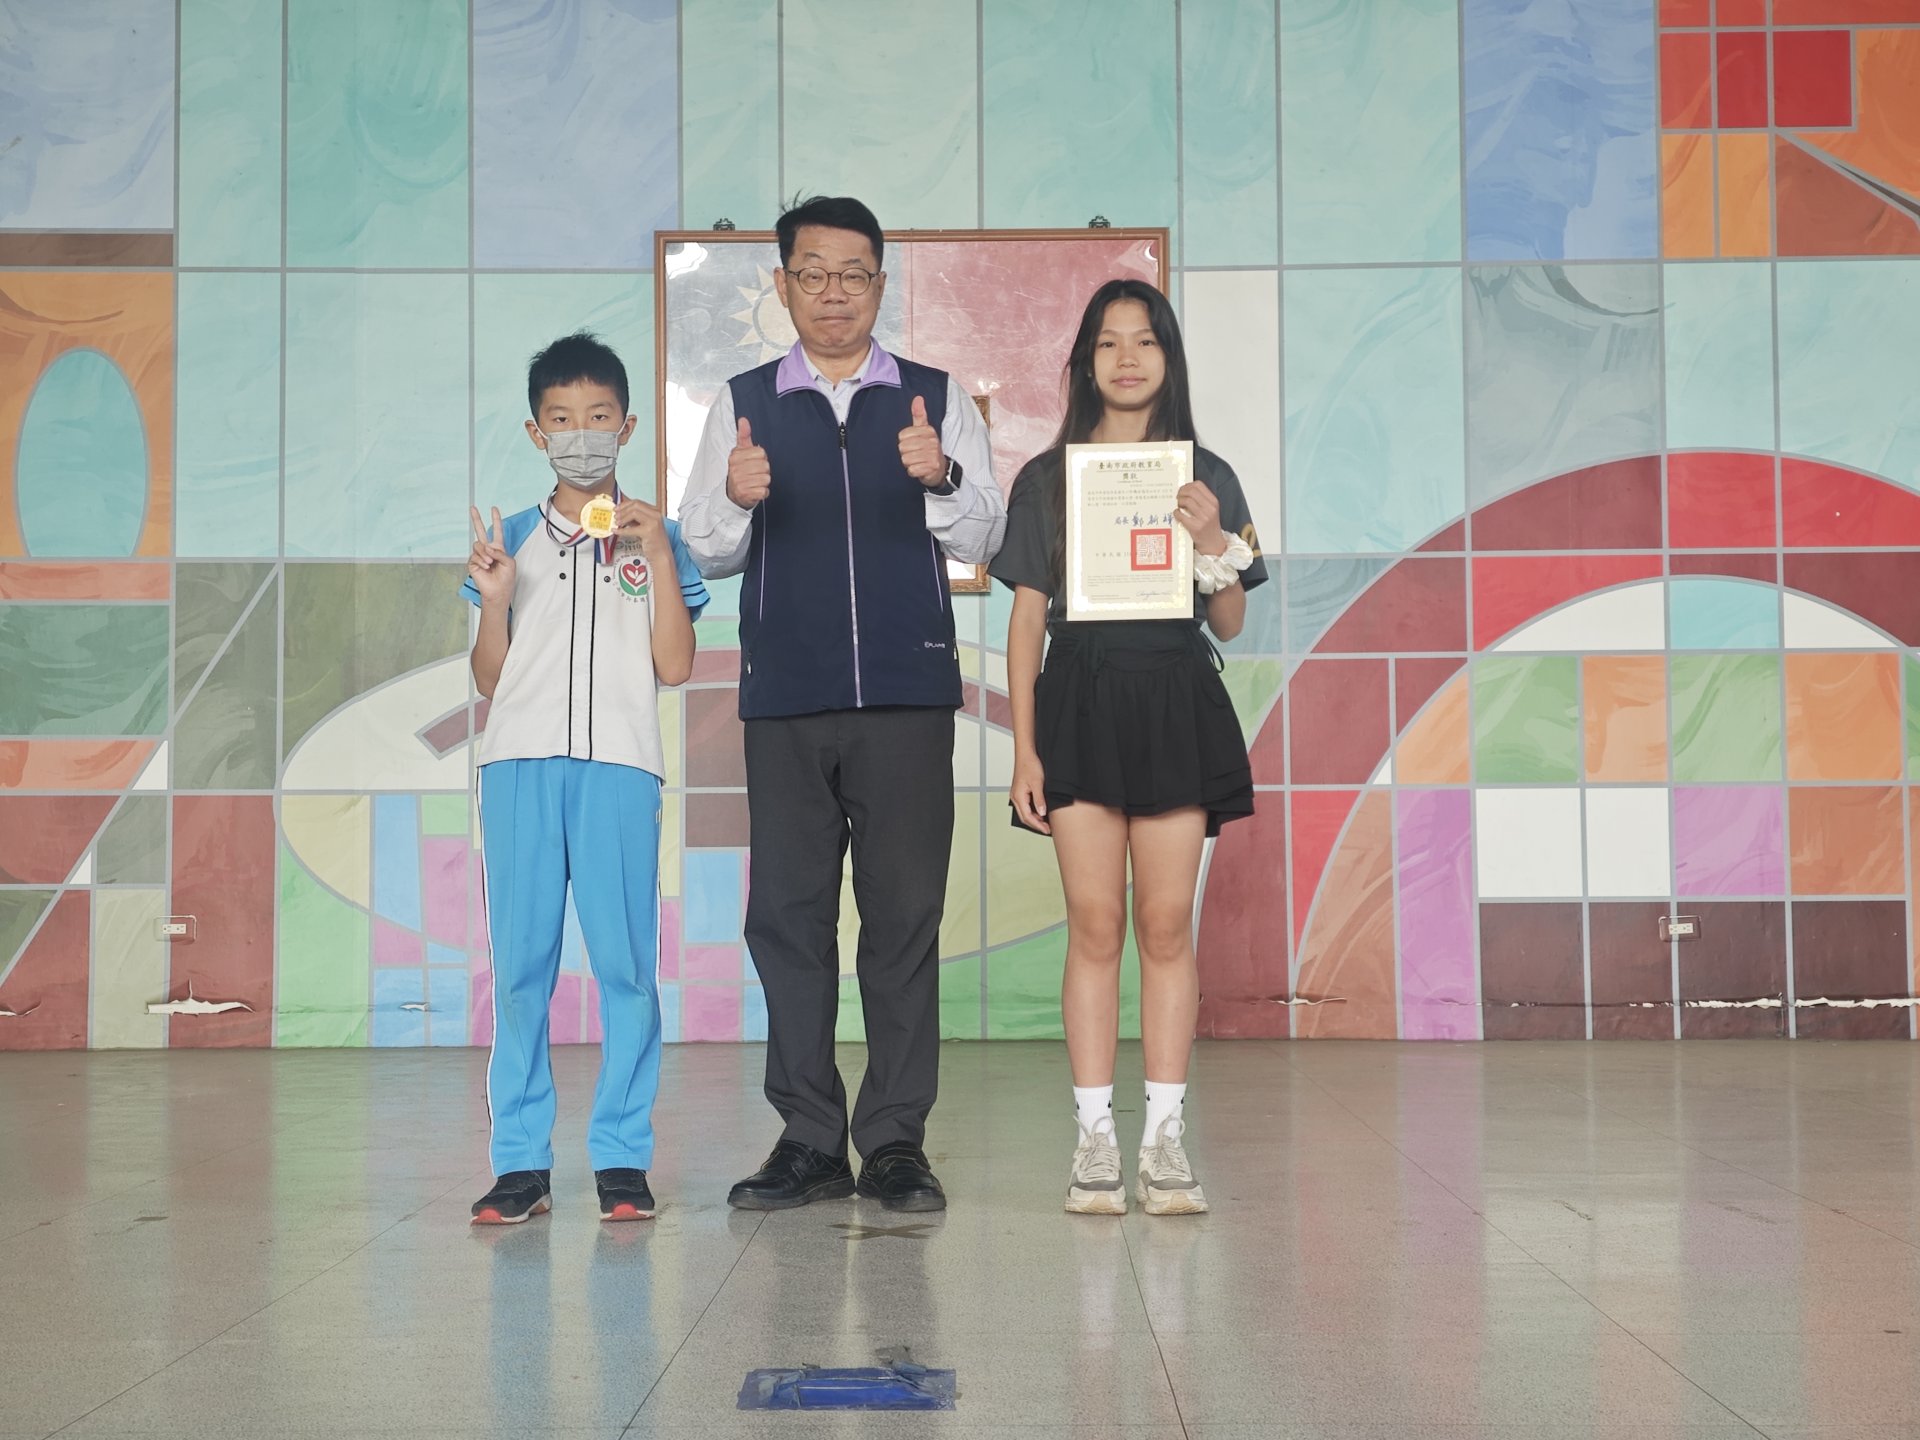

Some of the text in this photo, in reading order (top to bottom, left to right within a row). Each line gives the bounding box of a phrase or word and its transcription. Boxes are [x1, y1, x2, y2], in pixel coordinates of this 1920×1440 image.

[1099, 461, 1161, 469] 臺南市政府教育局
